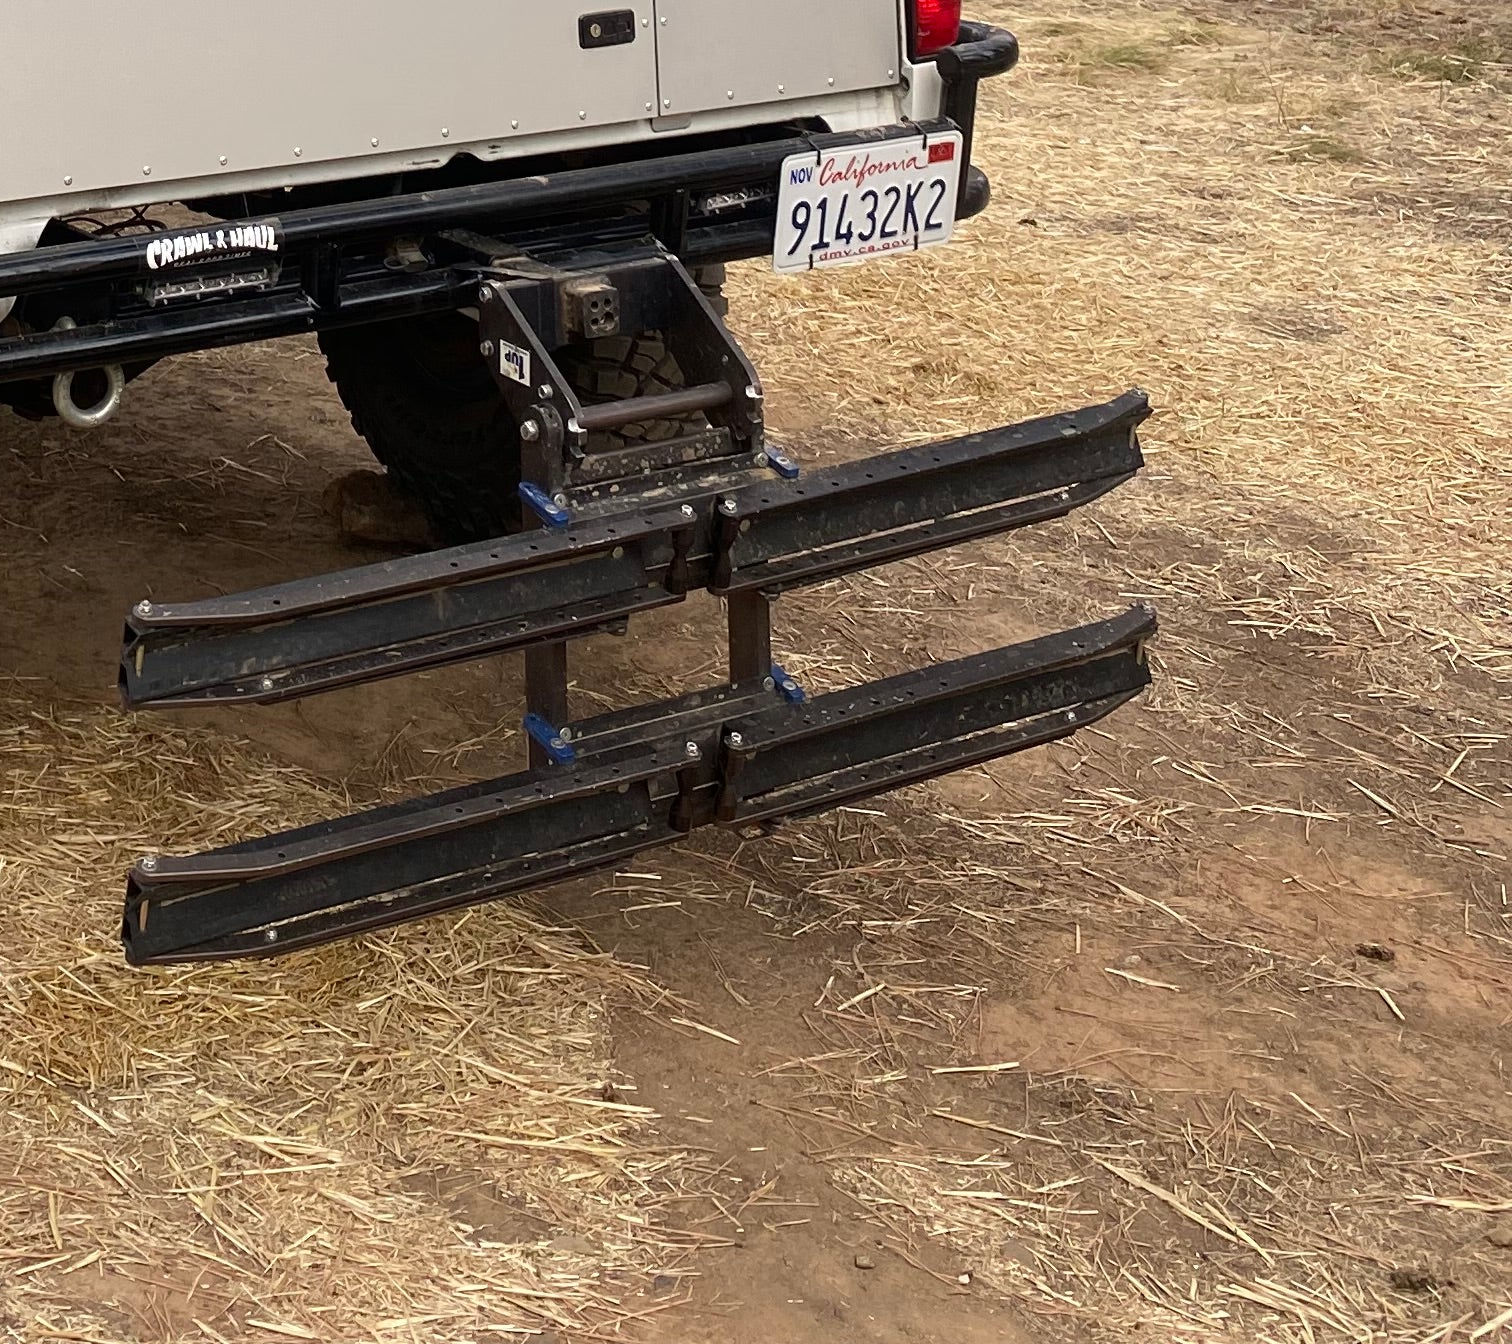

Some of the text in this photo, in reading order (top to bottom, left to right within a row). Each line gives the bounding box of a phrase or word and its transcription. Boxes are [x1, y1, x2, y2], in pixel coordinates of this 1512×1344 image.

[790, 167, 814, 186] NOV
[819, 154, 928, 189] California
[787, 178, 947, 256] 91432K2
[146, 232, 214, 269] CRAWL
[229, 224, 279, 252] HAUL
[819, 239, 910, 262] dmv.ca.gov
